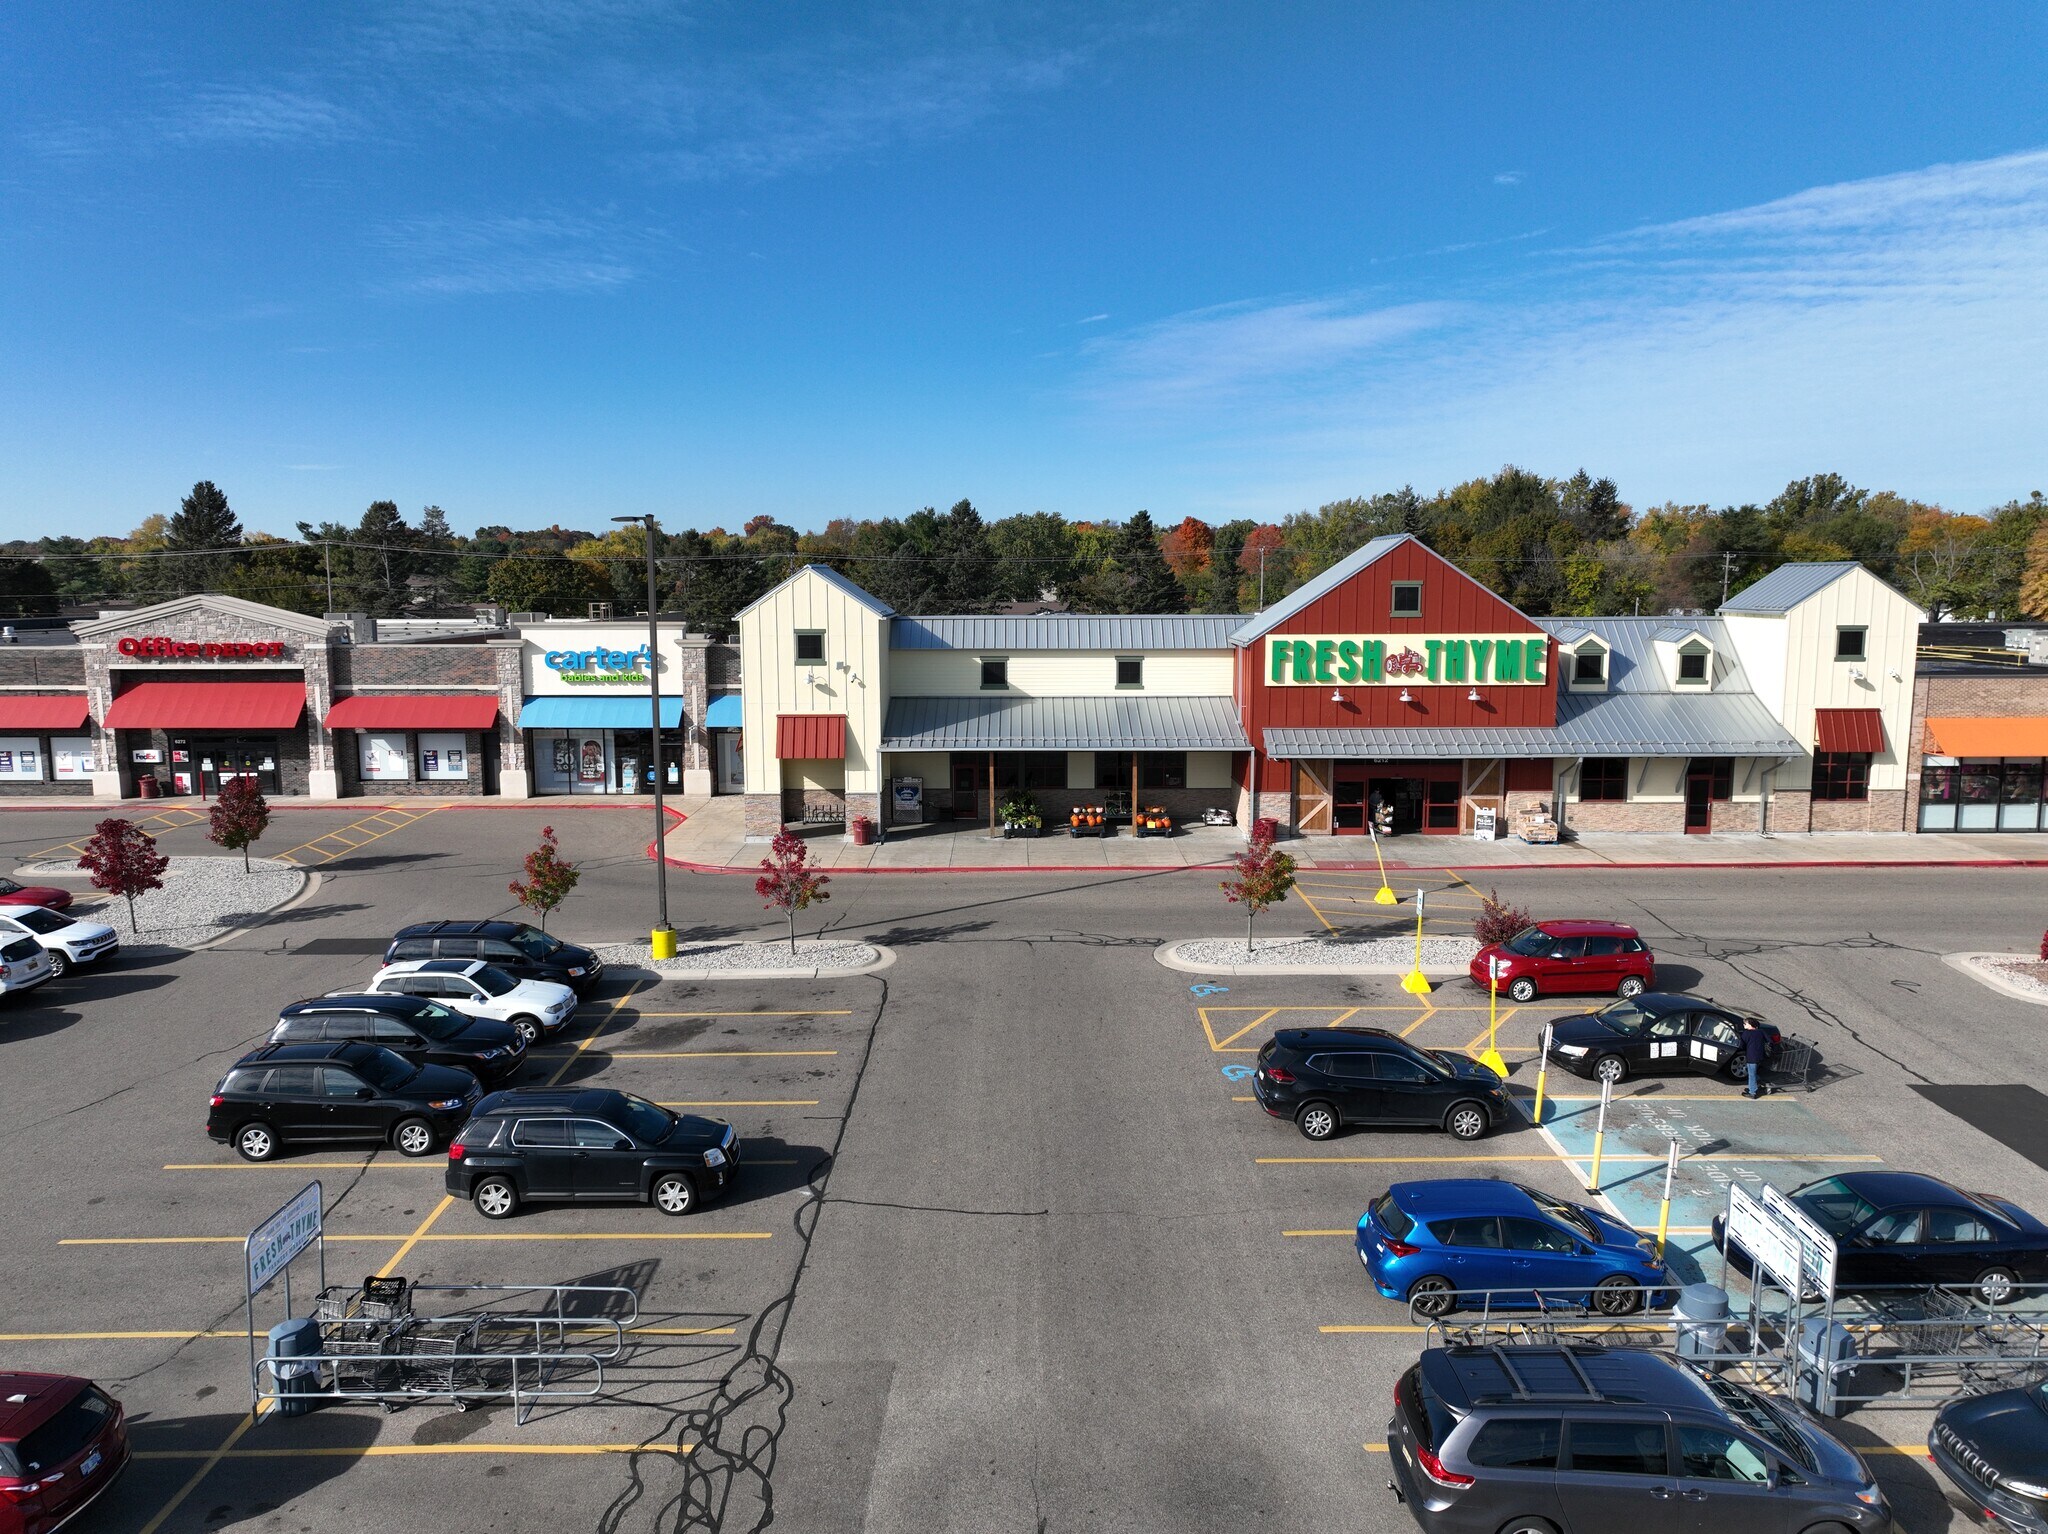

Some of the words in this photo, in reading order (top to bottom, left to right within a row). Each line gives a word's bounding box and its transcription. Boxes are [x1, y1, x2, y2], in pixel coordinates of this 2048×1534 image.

[118, 637, 199, 657] Office
[206, 642, 284, 657] DEPOT
[1271, 640, 1383, 682] FRESH
[1425, 639, 1545, 682] THYME
[561, 672, 596, 682] babies
[600, 672, 619, 682] and
[622, 672, 644, 682] kids
[556, 753, 574, 765] 50
[253, 1236, 283, 1280] FRESH
[289, 1209, 318, 1241] THYME
